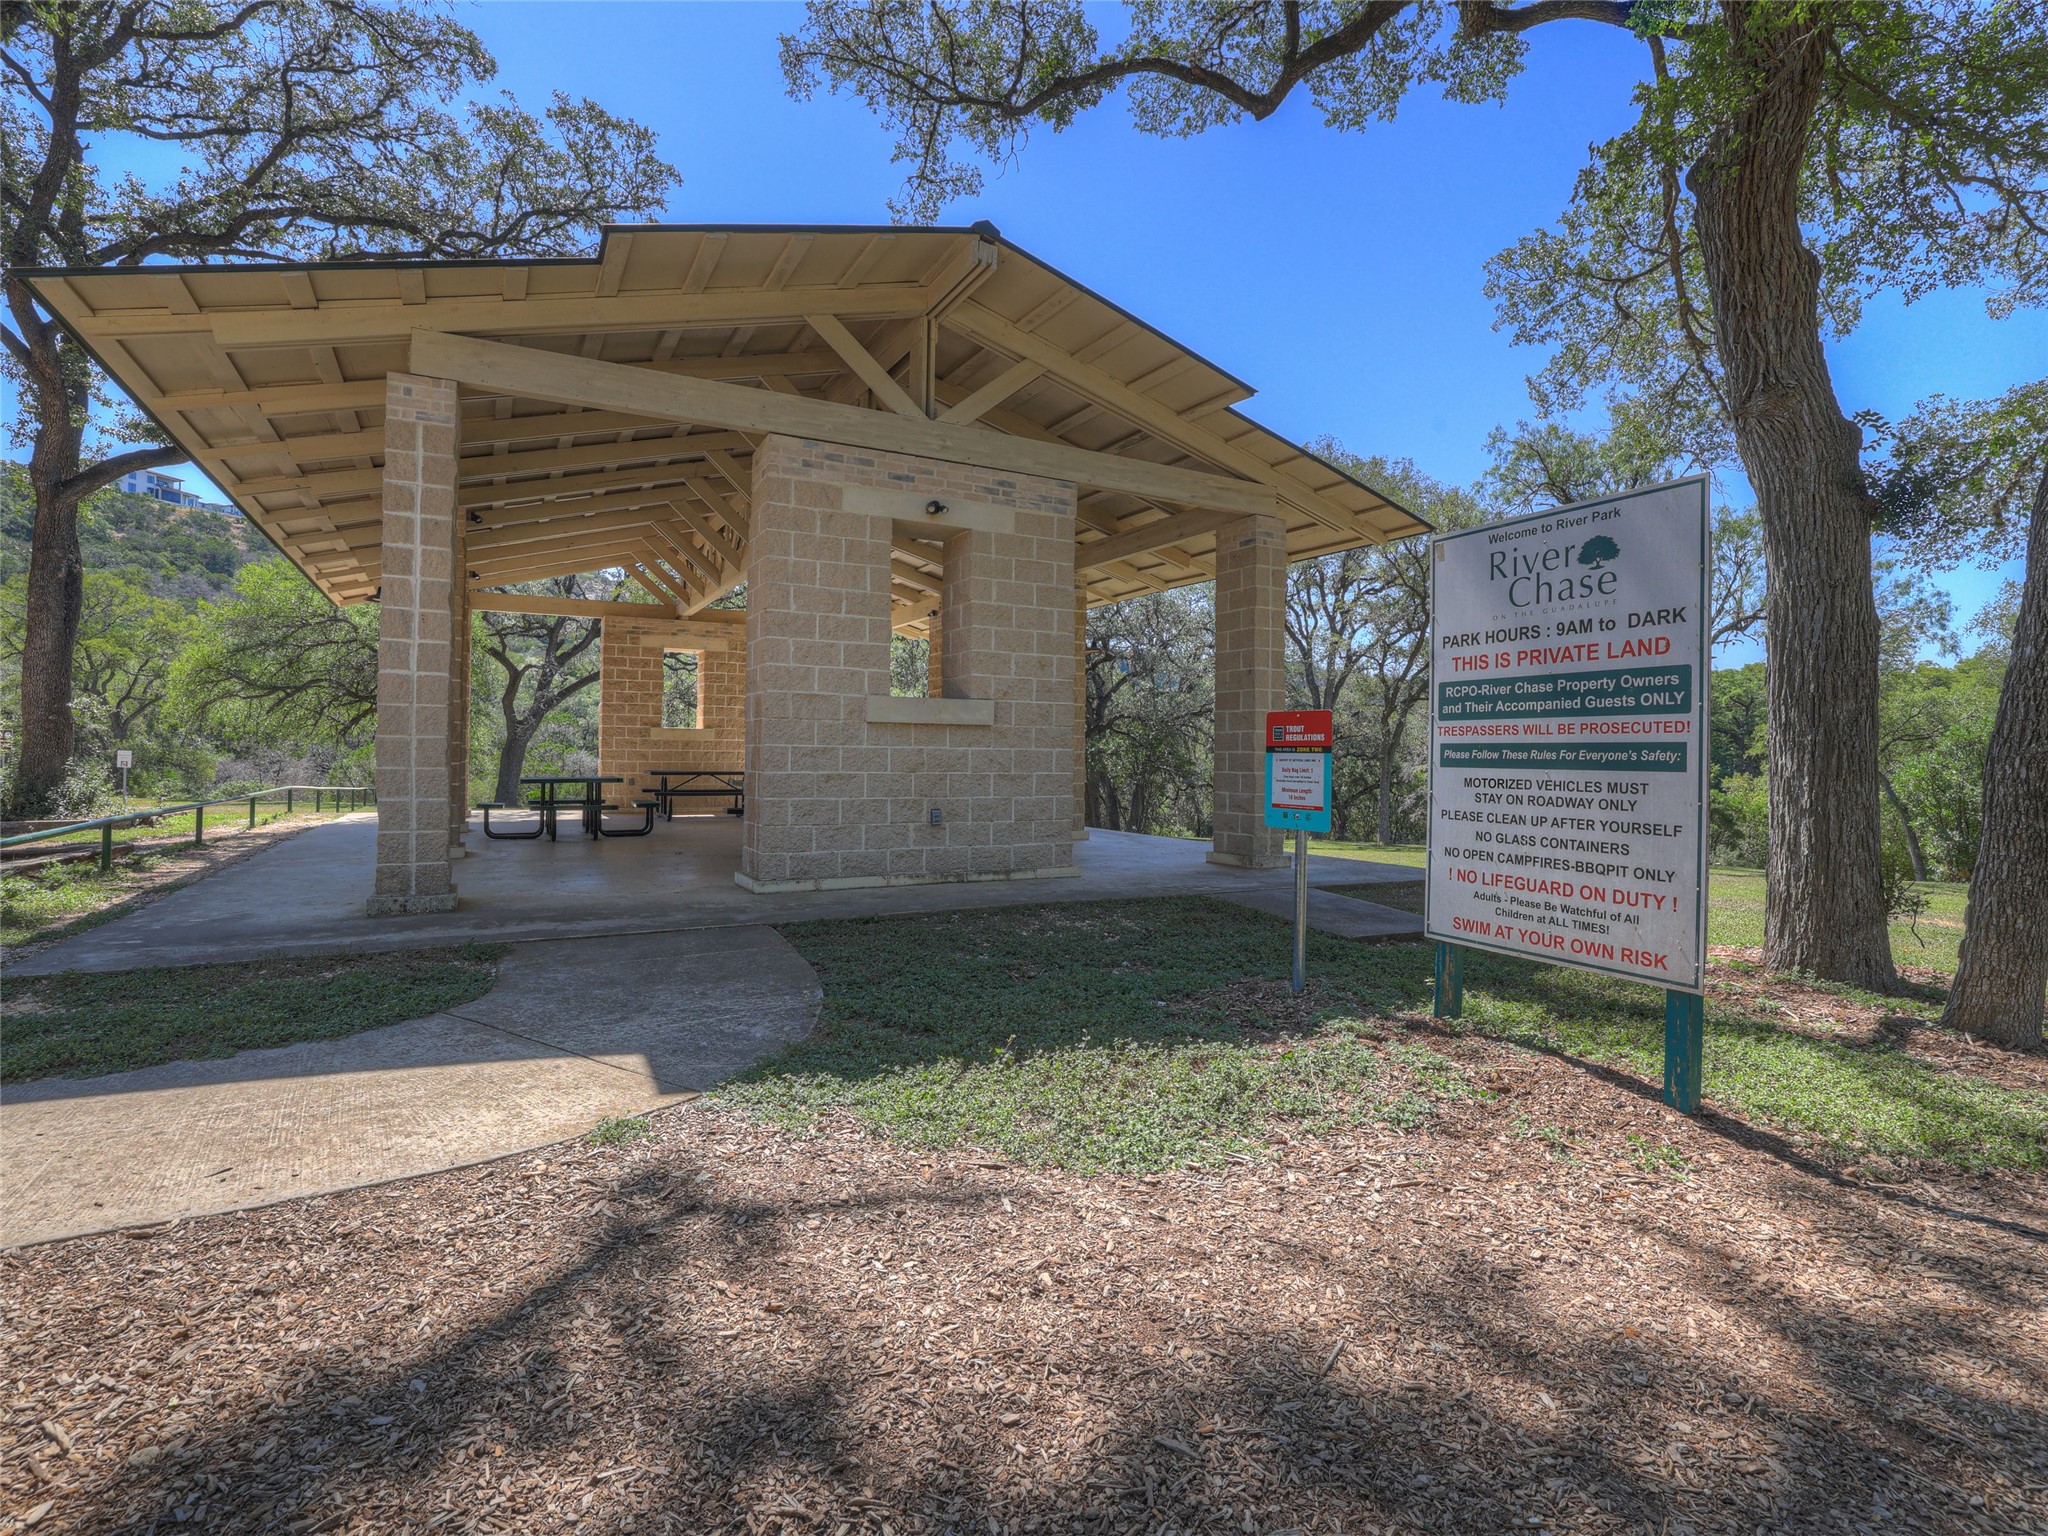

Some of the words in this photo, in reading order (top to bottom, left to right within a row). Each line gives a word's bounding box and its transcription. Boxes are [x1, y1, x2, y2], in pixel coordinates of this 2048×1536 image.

[1488, 527, 1537, 545] Welcome
[1541, 522, 1552, 533] to
[1556, 516, 1587, 530] River
[1592, 508, 1621, 522] Park
[1490, 544, 1575, 580] River
[1509, 570, 1617, 607] Chase
[1515, 610, 1534, 618] THE
[1543, 599, 1617, 614] GUADALUPE
[1443, 633, 1480, 649] PARK
[1485, 626, 1540, 645] HOURS
[1556, 619, 1593, 636] 9AM
[1600, 617, 1616, 631] to
[1628, 607, 1687, 629] DARK
[1452, 654, 1489, 672] THIS
[1495, 652, 1511, 668] IS
[1517, 643, 1600, 667] PRIVATE
[1607, 637, 1671, 659] LAND
[1446, 684, 1512, 698] RCPO-River
[1515, 681, 1553, 694] Chase
[1557, 676, 1616, 695] Property
[1621, 675, 1679, 687] Owners
[1443, 703, 1461, 714] and
[1465, 701, 1493, 713] Their
[1495, 698, 1580, 714] Accompanied
[1585, 694, 1636, 707] Guests
[1640, 691, 1685, 705] ONLY
[1438, 725, 1519, 736] TRESPASSERS
[1523, 724, 1553, 735] WILL
[1557, 723, 1575, 735] BE
[1580, 721, 1691, 734] PROSECUTED!
[1444, 750, 1470, 759] Please
[1472, 750, 1499, 759] Follow
[1502, 750, 1528, 760] These
[1530, 750, 1557, 760] Rules
[1559, 750, 1576, 760] For
[1579, 750, 1637, 763] Everyone's
[1640, 750, 1681, 763] Safety:
[1464, 778, 1532, 790] MOTORIZED
[1536, 780, 1603, 793] VEHICLES
[1607, 782, 1649, 795] MUST
[1475, 793, 1503, 804] STAY
[1506, 794, 1523, 806] ON
[1528, 796, 1596, 809] ROADWAY
[1599, 799, 1637, 812] ONLY
[1441, 810, 1483, 822] PLEASE
[1487, 813, 1526, 826] CLEAN
[1531, 816, 1547, 827] UP
[1550, 817, 1595, 831] AFTER
[1600, 821, 1682, 838] YOURSELF
[1475, 831, 1492, 842] NO
[1495, 833, 1536, 847] GLASS
[1540, 837, 1630, 855] CONTAINERS
[1444, 847, 1460, 858] NO
[1463, 849, 1494, 862] OPEN
[1497, 853, 1629, 877] CAMPFIRES-BBQPIT
[1633, 868, 1676, 883] ONLY
[1449, 868, 1452, 880] !
[1457, 870, 1477, 884] NO
[1482, 872, 1574, 897] LIFEGUARD
[1580, 885, 1606, 902] ON
[1612, 889, 1666, 910] DUTY
[1673, 897, 1678, 912] !
[1473, 891, 1501, 903] Adults
[1510, 897, 1541, 910] Please
[1544, 901, 1557, 911] Be
[1560, 904, 1607, 920] Watchful
[1610, 912, 1622, 921] of
[1624, 913, 1639, 925] All
[1495, 908, 1534, 922] Children
[1537, 914, 1546, 923] at
[1548, 917, 1569, 928] ALL
[1571, 920, 1609, 935] TIMES!
[1453, 917, 1491, 936] SWIM
[1495, 924, 1514, 940] AT
[1518, 928, 1564, 950] YOUR
[1571, 939, 1614, 960] OWN
[1621, 948, 1668, 970] RISK
